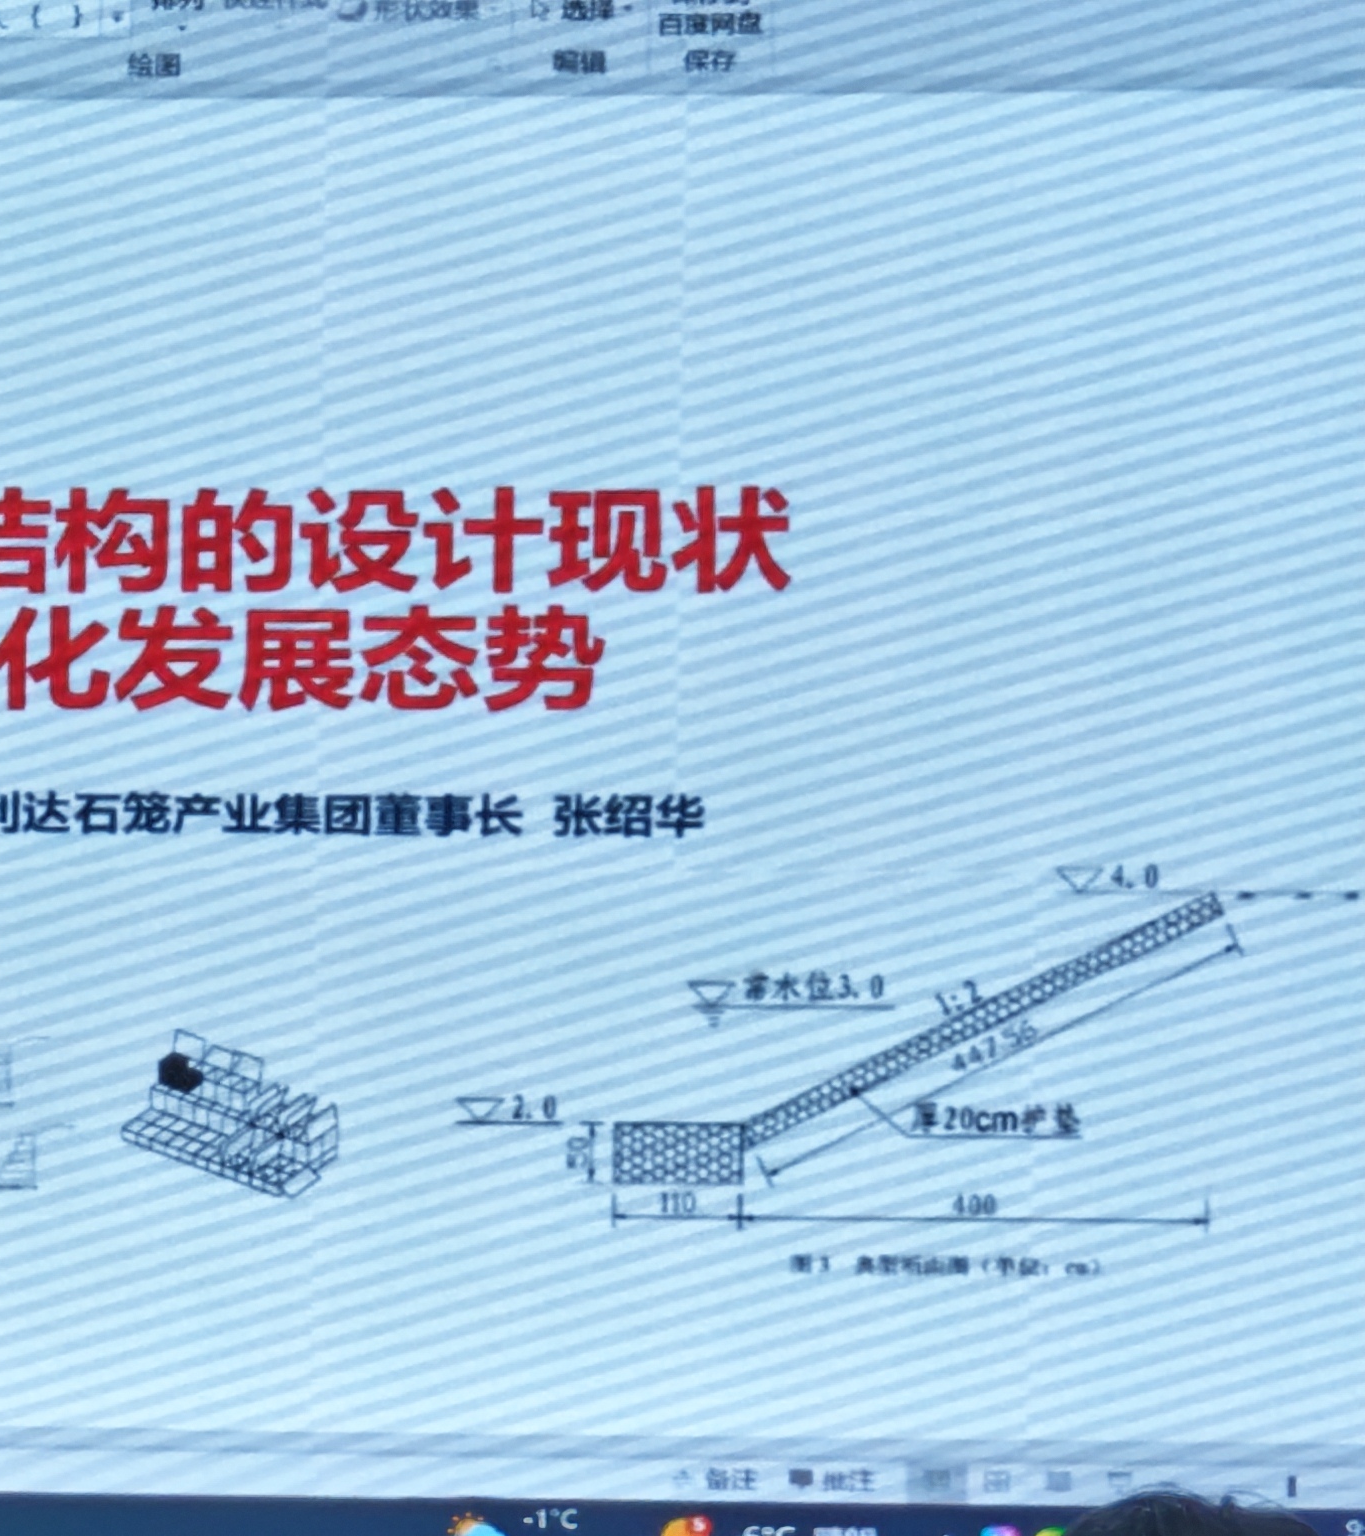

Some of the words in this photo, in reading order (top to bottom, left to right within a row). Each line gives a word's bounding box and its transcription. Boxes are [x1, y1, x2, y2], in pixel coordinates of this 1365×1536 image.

[659, 12, 763, 36] 百度网盘
[128, 53, 181, 78] 绘图
[682, 49, 737, 73] 保存
[553, 791, 707, 838] 张绍华
[1110, 864, 1159, 889] 4.0
[512, 1094, 557, 1120] 2.0
[660, 1191, 697, 1214] 110
